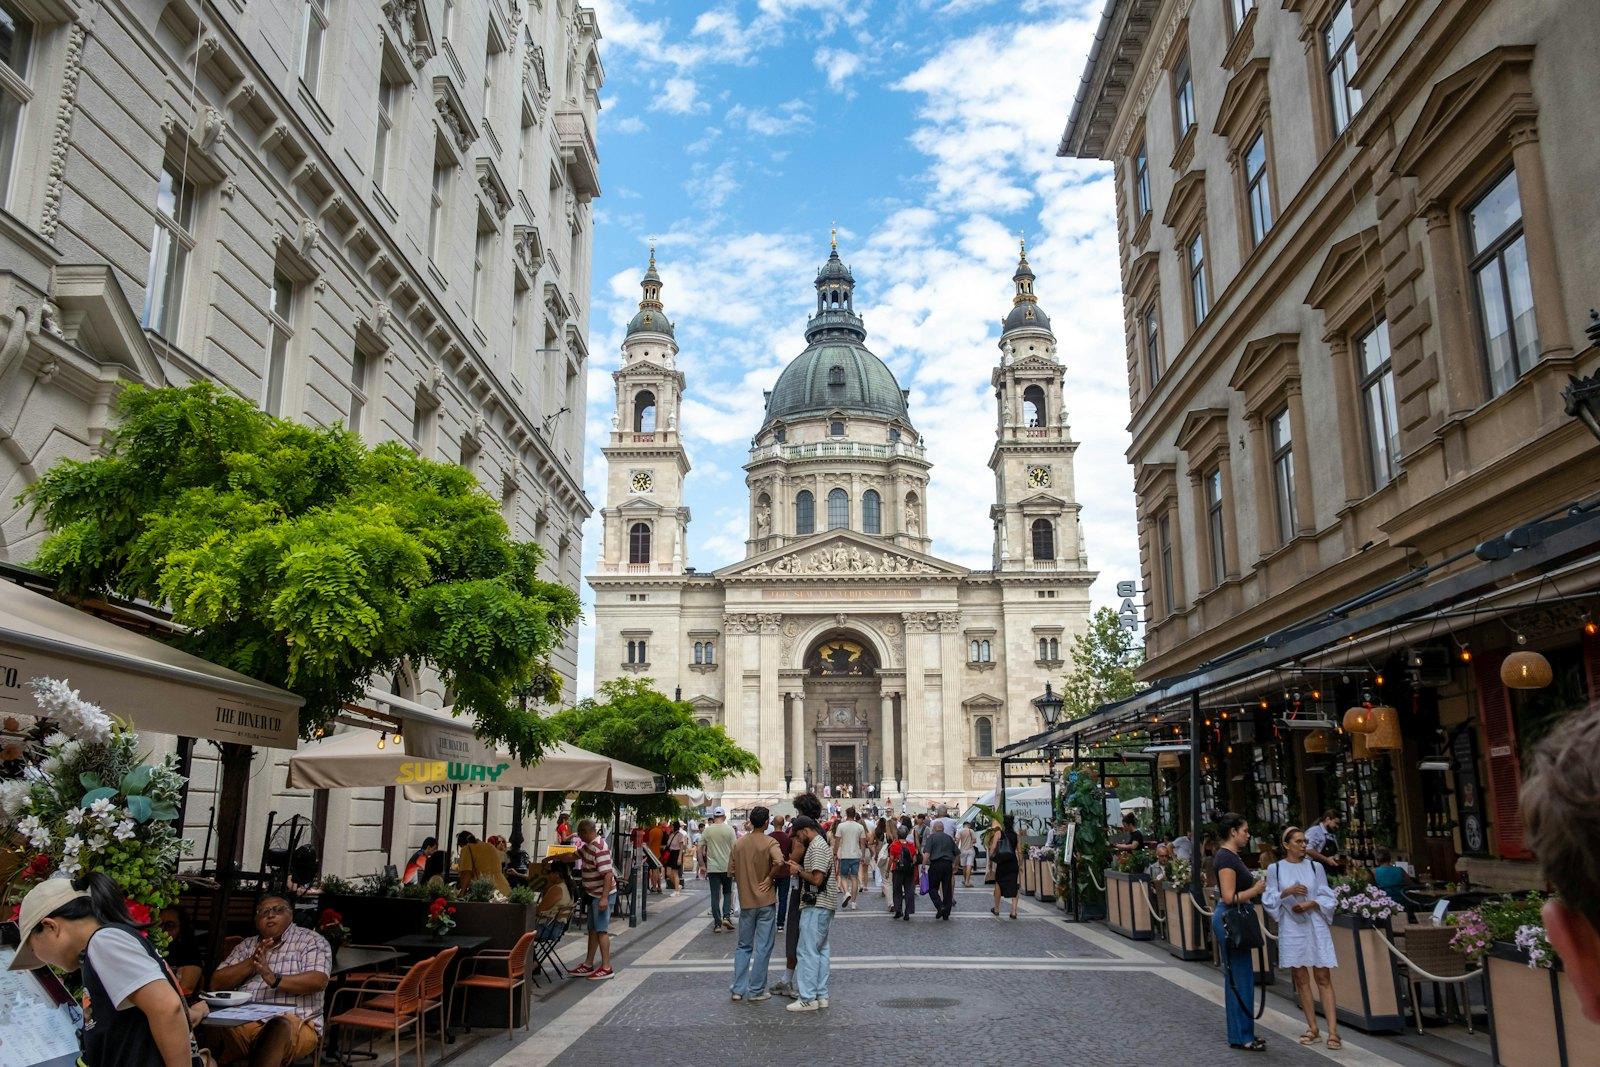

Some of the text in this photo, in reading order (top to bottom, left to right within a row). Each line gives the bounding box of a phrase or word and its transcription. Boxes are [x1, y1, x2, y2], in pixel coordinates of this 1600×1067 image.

[216, 706, 236, 724] THE
[237, 711, 267, 730] DINER
[395, 760, 511, 784] SUBWAY
